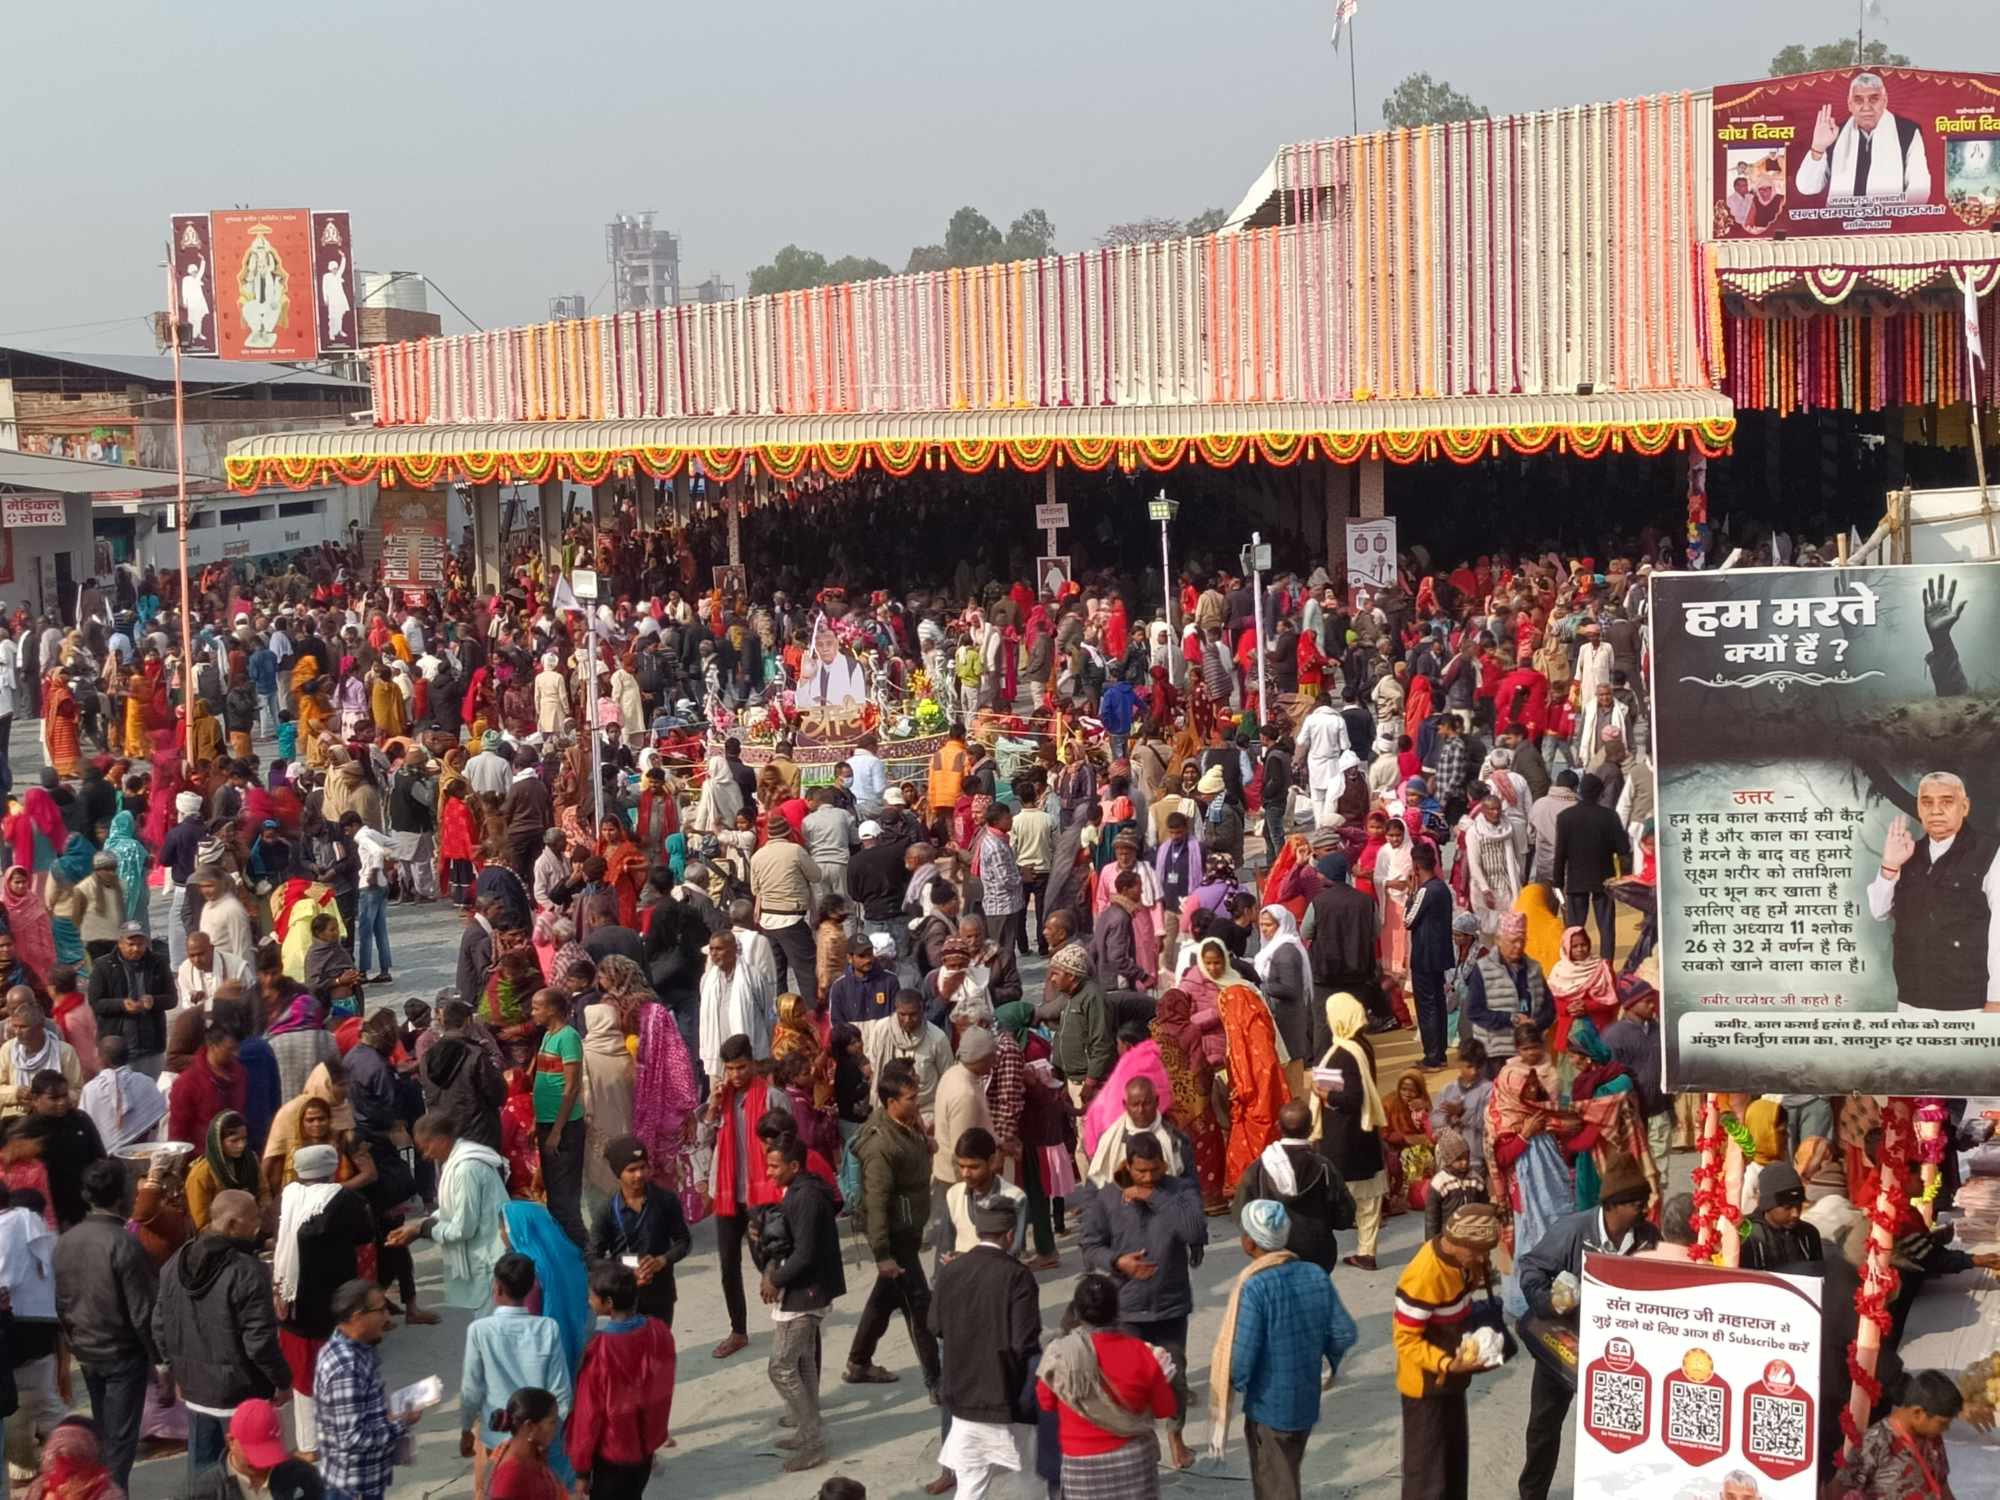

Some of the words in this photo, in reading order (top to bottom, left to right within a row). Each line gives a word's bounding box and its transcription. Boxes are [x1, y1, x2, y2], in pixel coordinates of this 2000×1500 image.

[1717, 123, 1748, 140] बोध
[1752, 122, 1795, 139] दिवस
[1935, 115, 1977, 133] निर्वाण
[1979, 114, 2000, 131] दिव
[5, 497, 60, 510] मेडिकल
[19, 511, 48, 523] सेवा
[1682, 599, 1761, 637] हम
[1770, 581, 1879, 628] मरते
[1723, 634, 1789, 663] क्यों
[1793, 632, 1820, 665] हैं
[1829, 639, 1849, 662] ?
[1732, 791, 1775, 805] उत्तर
[1668, 813, 1690, 827] हम
[1696, 813, 1720, 824] सब
[1725, 812, 1758, 824] काल
[1764, 807, 1808, 823] कसाई
[1814, 806, 1833, 822] की
[1839, 806, 1864, 823] कैद
[1681, 828, 1692, 843] में
[1715, 827, 1743, 842] और
[1750, 831, 1782, 841] काल
[1789, 830, 1808, 841] का
[1815, 825, 1853, 841] स्वार्थ
[1699, 846, 1730, 861] मरने
[1736, 846, 1751, 861] के
[1757, 849, 1783, 862] बाद
[1789, 849, 1810, 862] वह
[1816, 845, 1852, 862] हमारे
[1684, 868, 1717, 885] सूक्ष्म
[1724, 864, 1760, 879] शरीर
[1766, 864, 1785, 879] को
[1791, 863, 1852, 879] तप्तशिला
[1699, 887, 1717, 898] पर
[1725, 887, 1747, 903] भून
[1754, 886, 1777, 897] कर
[1783, 886, 1822, 898] खाता
[1684, 901, 1734, 918] इसलिए
[1740, 905, 1760, 919] वह
[1767, 901, 1788, 919] हमें
[1795, 904, 1837, 916] मारता
[1692, 920, 1727, 935] गीता
[1733, 922, 1784, 935] अध्याय
[1790, 920, 1804, 934] 11
[1811, 920, 1853, 934] श्लोक
[1685, 939, 1707, 953] 26
[1712, 938, 1726, 953] से
[1732, 939, 1754, 953] 32
[1761, 938, 1772, 953] में
[1778, 937, 1814, 953] वर्णन
[1836, 937, 1857, 952] कि
[1681, 957, 1724, 972] सबको
[1730, 956, 1763, 971] खाने
[1769, 960, 1803, 971] वाला
[1810, 960, 1842, 971] काल
[1700, 993, 1729, 1005] कबीर
[1735, 993, 1776, 1005] परमेश्वर
[1780, 993, 1796, 1005] जी
[1801, 993, 1829, 1007] कहते
[1754, 1020, 1781, 1029] काल
[1784, 1018, 1819, 1030] कसाई
[1869, 1018, 1888, 1030] सर्व
[1892, 1019, 1919, 1029] लोक
[1922, 1018, 1939, 1029] को
[1690, 1032, 1730, 1048] अंकुश
[1735, 1032, 1777, 1048] निर्गुण
[1782, 1035, 1809, 1045] नाम
[1841, 1036, 1892, 1049] सतगुरु
[1896, 1036, 1913, 1047] दर
[1606, 1296, 1631, 1311] संत
[1635, 1302, 1690, 1320] रामपाल
[1693, 1307, 1713, 1322] जी
[1718, 1313, 1777, 1331] महाराज
[1780, 1322, 1791, 1333] से
[1592, 1314, 1611, 1329] जुड़े
[1615, 1317, 1639, 1329] रहने
[1642, 1320, 1654, 1331] के
[1658, 1321, 1679, 1336] लिए
[1682, 1327, 1708, 1339] आज
[1712, 1329, 1724, 1342] ही
[1728, 1331, 1785, 1350] Subscribe
[1788, 1340, 1810, 1353] करें
